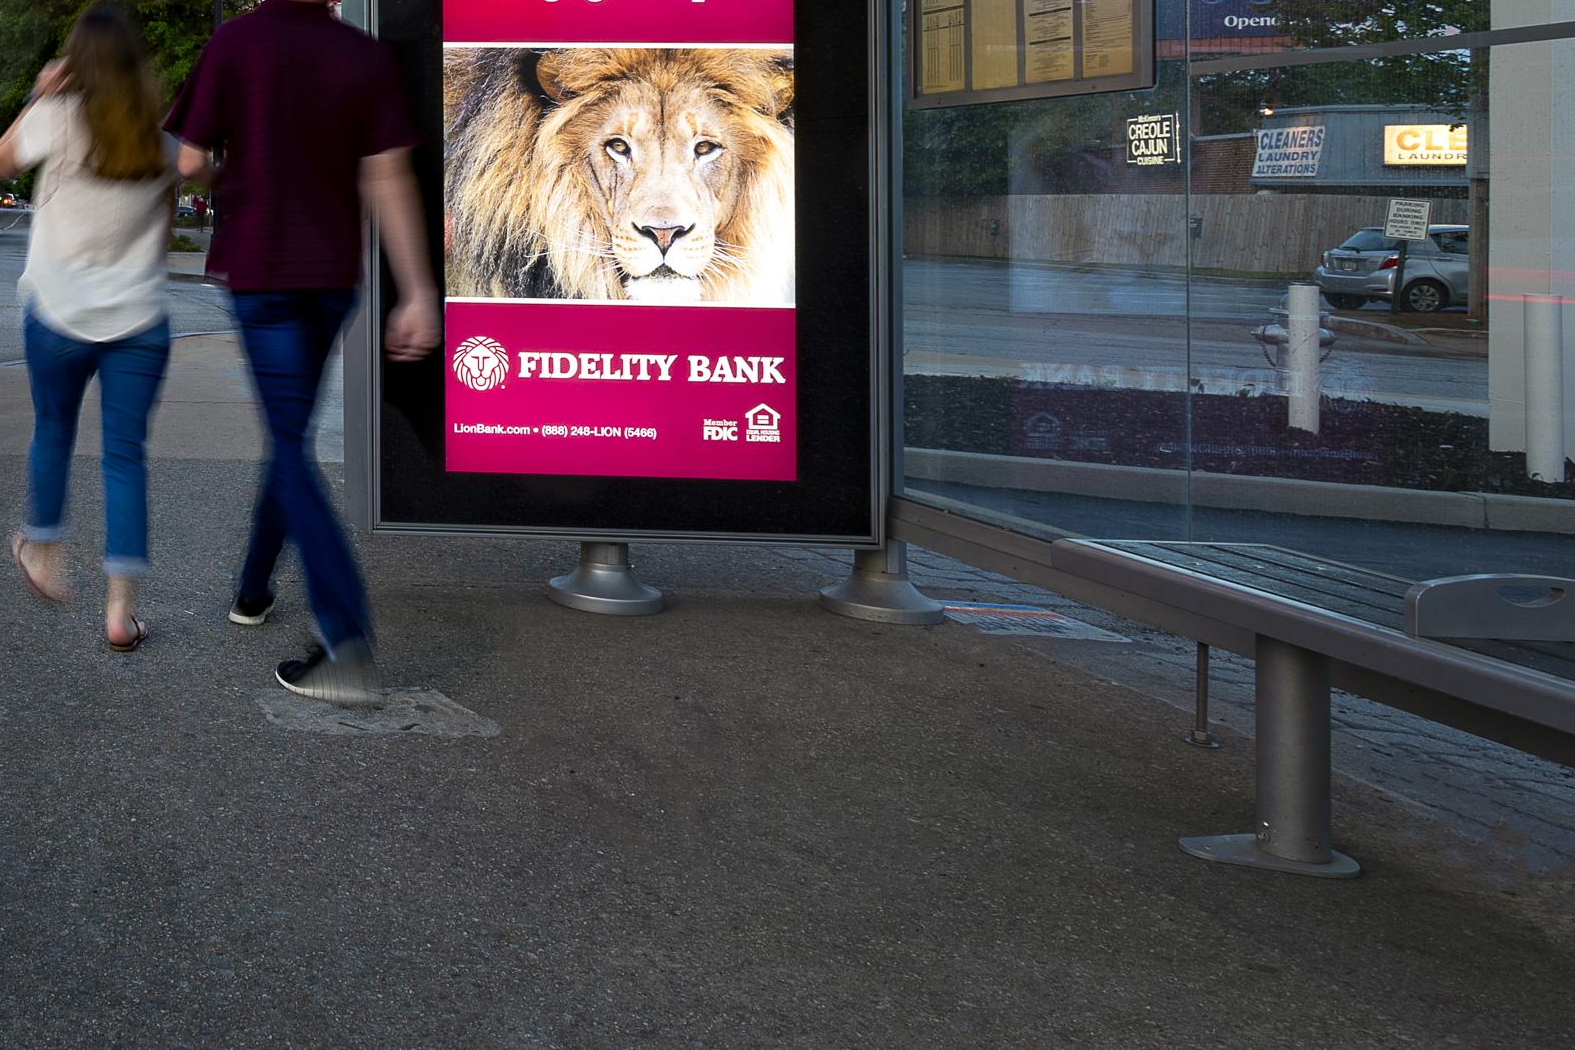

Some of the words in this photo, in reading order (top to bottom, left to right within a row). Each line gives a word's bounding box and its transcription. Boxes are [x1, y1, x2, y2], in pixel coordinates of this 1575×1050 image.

[1129, 122, 1170, 140] CREOLE
[1260, 128, 1323, 151] CLEANERS
[1132, 138, 1168, 156] CAJUN
[1137, 156, 1164, 166] CUISINE
[1258, 151, 1318, 163] LAUNDRY
[1256, 164, 1317, 176] ALTERATIONS
[1395, 201, 1425, 209] PARKING
[518, 351, 678, 381] FIDELITY
[687, 355, 786, 384] BANK
[703, 418, 737, 427] Member
[453, 423, 531, 436] LionBank.com
[541, 425, 568, 438] (888)
[570, 426, 621, 438] 248-LION
[624, 427, 657, 440] (5466)
[703, 427, 738, 441] FDIC
